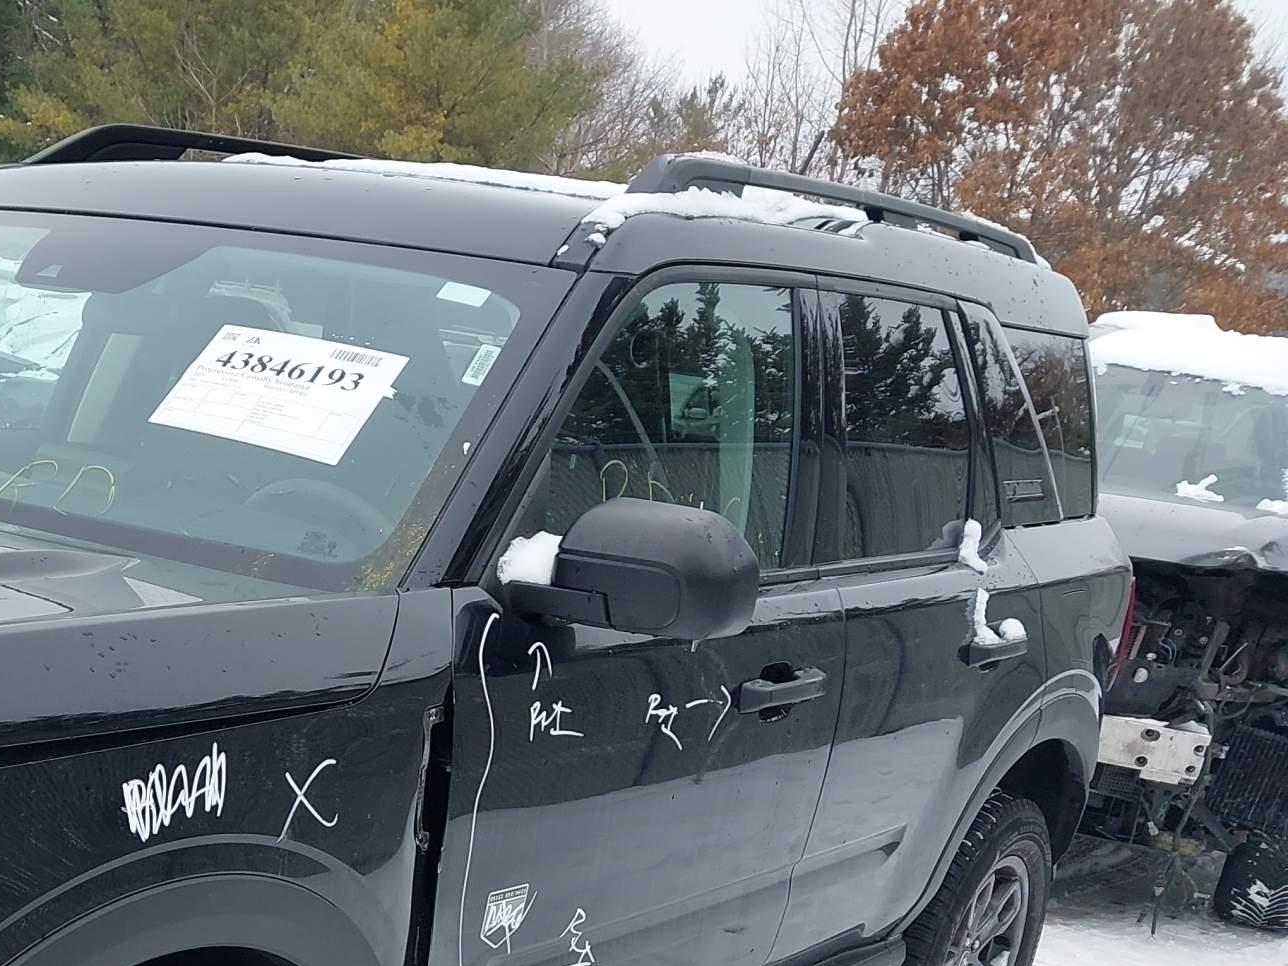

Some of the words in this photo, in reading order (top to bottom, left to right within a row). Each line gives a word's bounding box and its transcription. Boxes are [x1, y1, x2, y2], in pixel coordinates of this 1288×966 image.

[214, 349, 366, 392] 43846193
[489, 894, 504, 902] BIG
[504, 888, 527, 899] BEND
